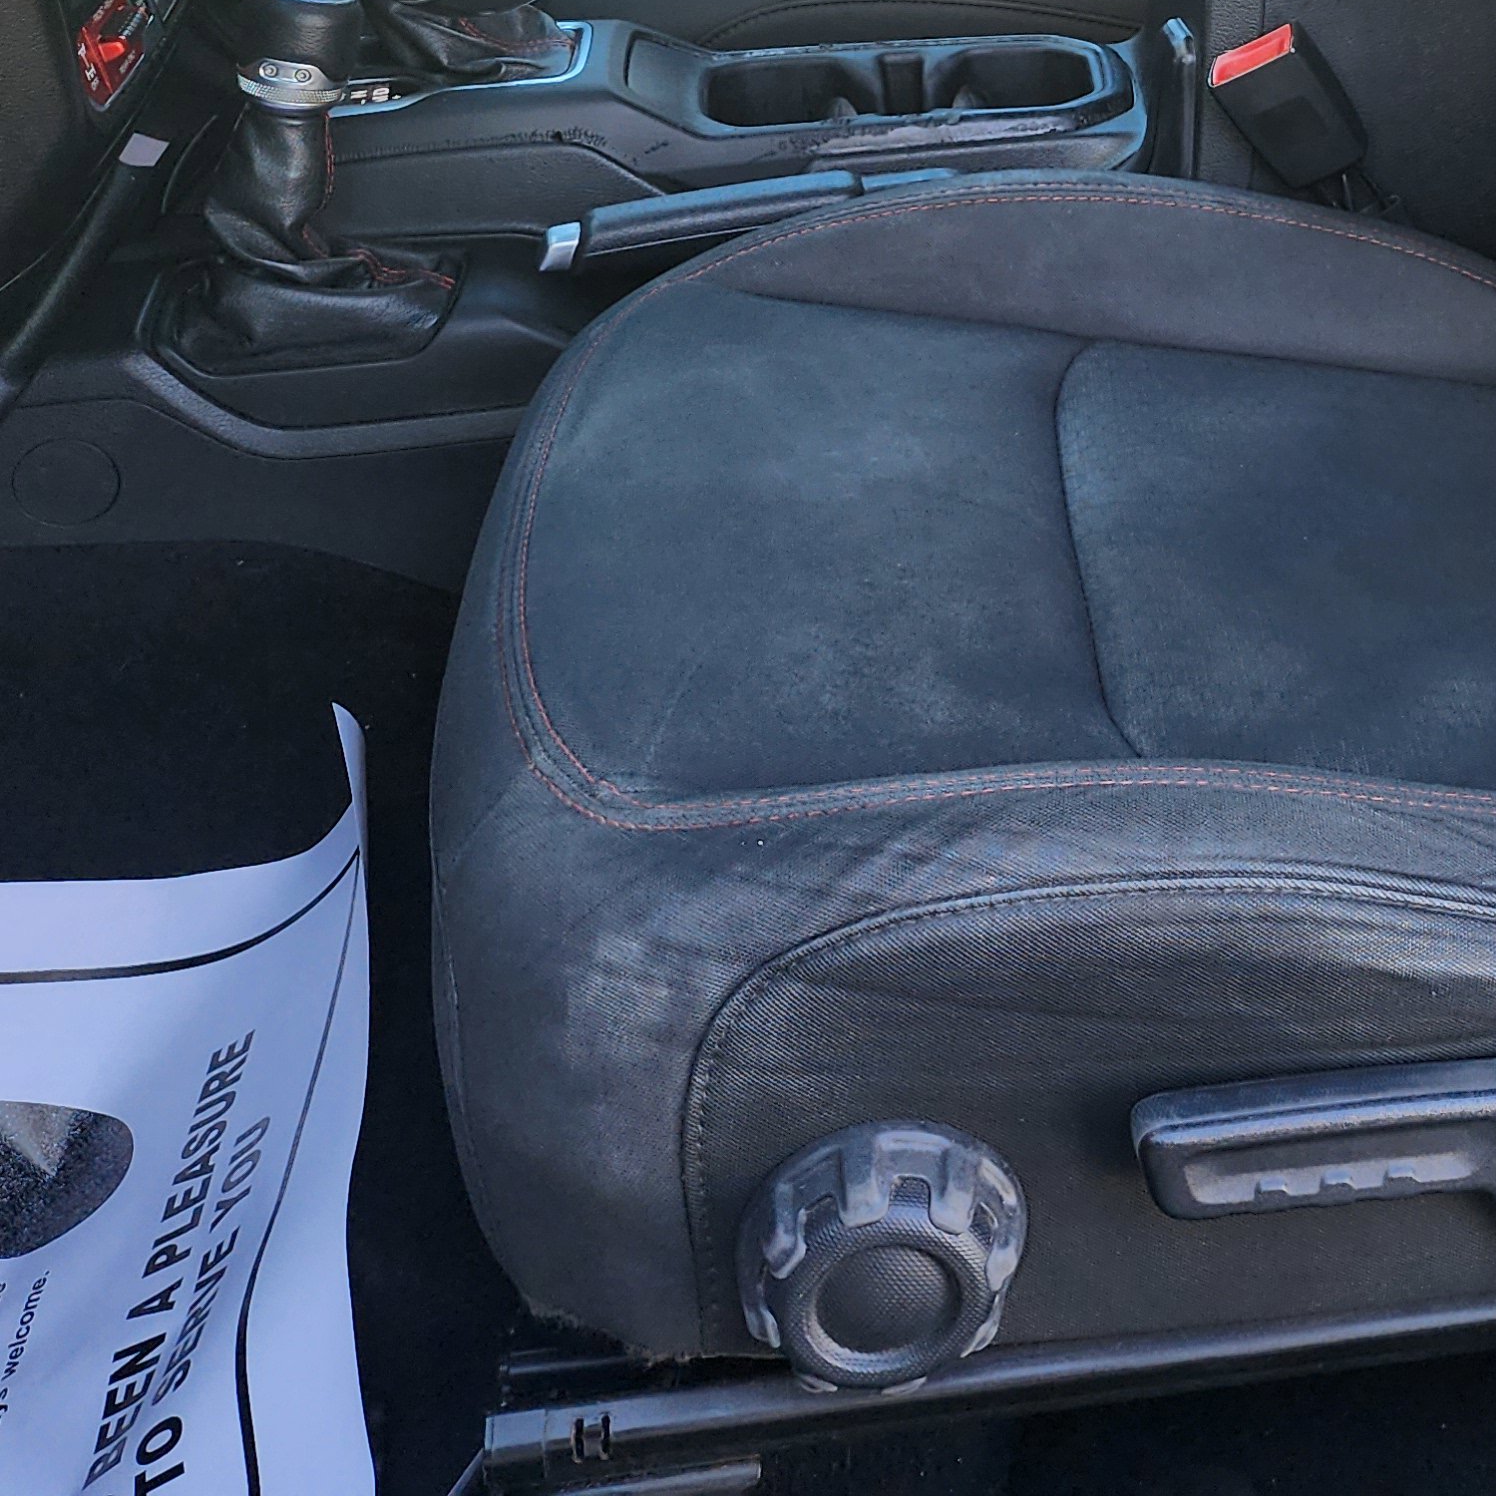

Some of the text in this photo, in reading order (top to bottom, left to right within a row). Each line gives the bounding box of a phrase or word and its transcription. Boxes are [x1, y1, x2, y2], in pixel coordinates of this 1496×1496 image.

[1, 1270, 50, 1381] welcome.
[82, 1029, 255, 1490] BEEN A PLEASURE
[134, 1116, 270, 1496] TO SERVE YOU
